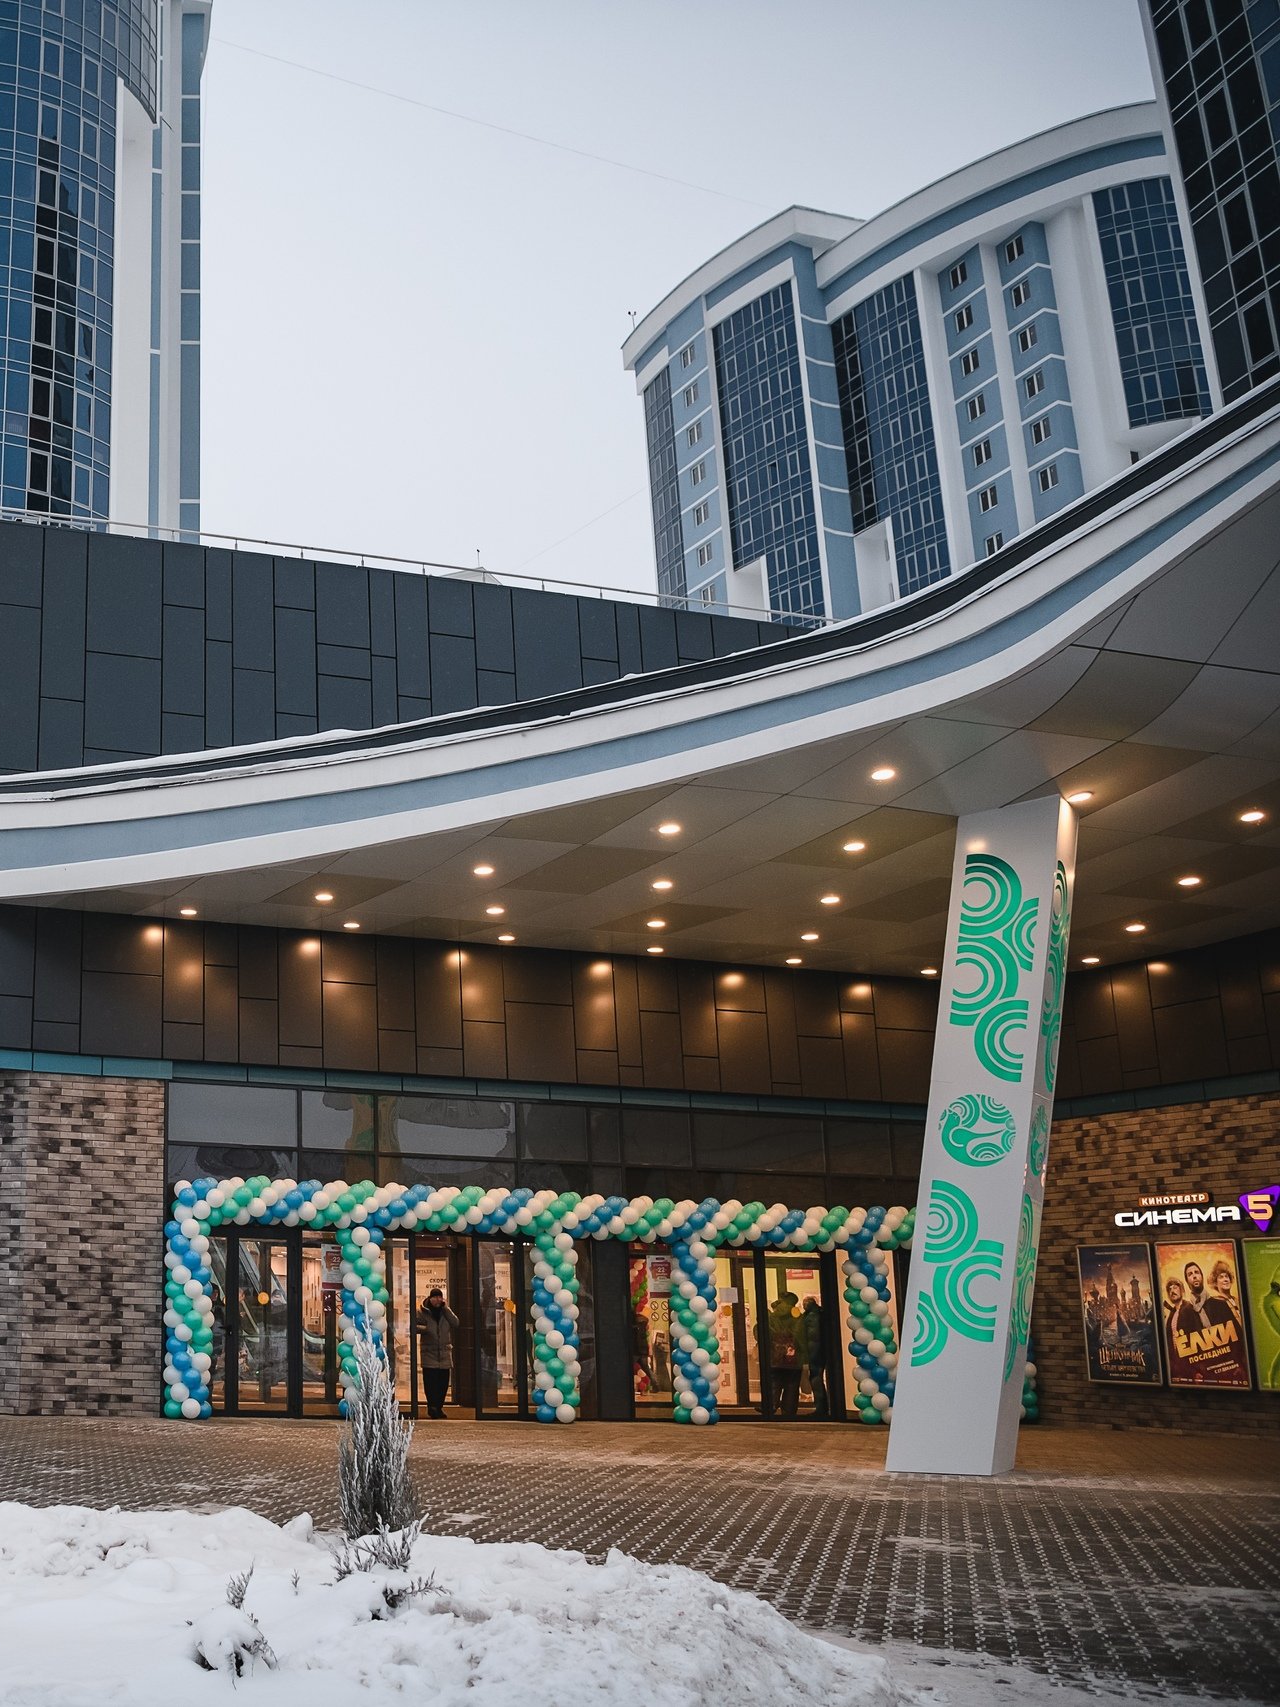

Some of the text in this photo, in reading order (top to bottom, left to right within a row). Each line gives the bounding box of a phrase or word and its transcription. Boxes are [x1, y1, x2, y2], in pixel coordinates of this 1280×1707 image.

[1114, 1194, 1274, 1227] СИНЕМА 5
[1141, 1193, 1206, 1206] КИНОТЕАТР
[1174, 1320, 1239, 1358] ЁЛКИ
[1188, 1345, 1232, 1364] ПОСЛЕДНИЕ
